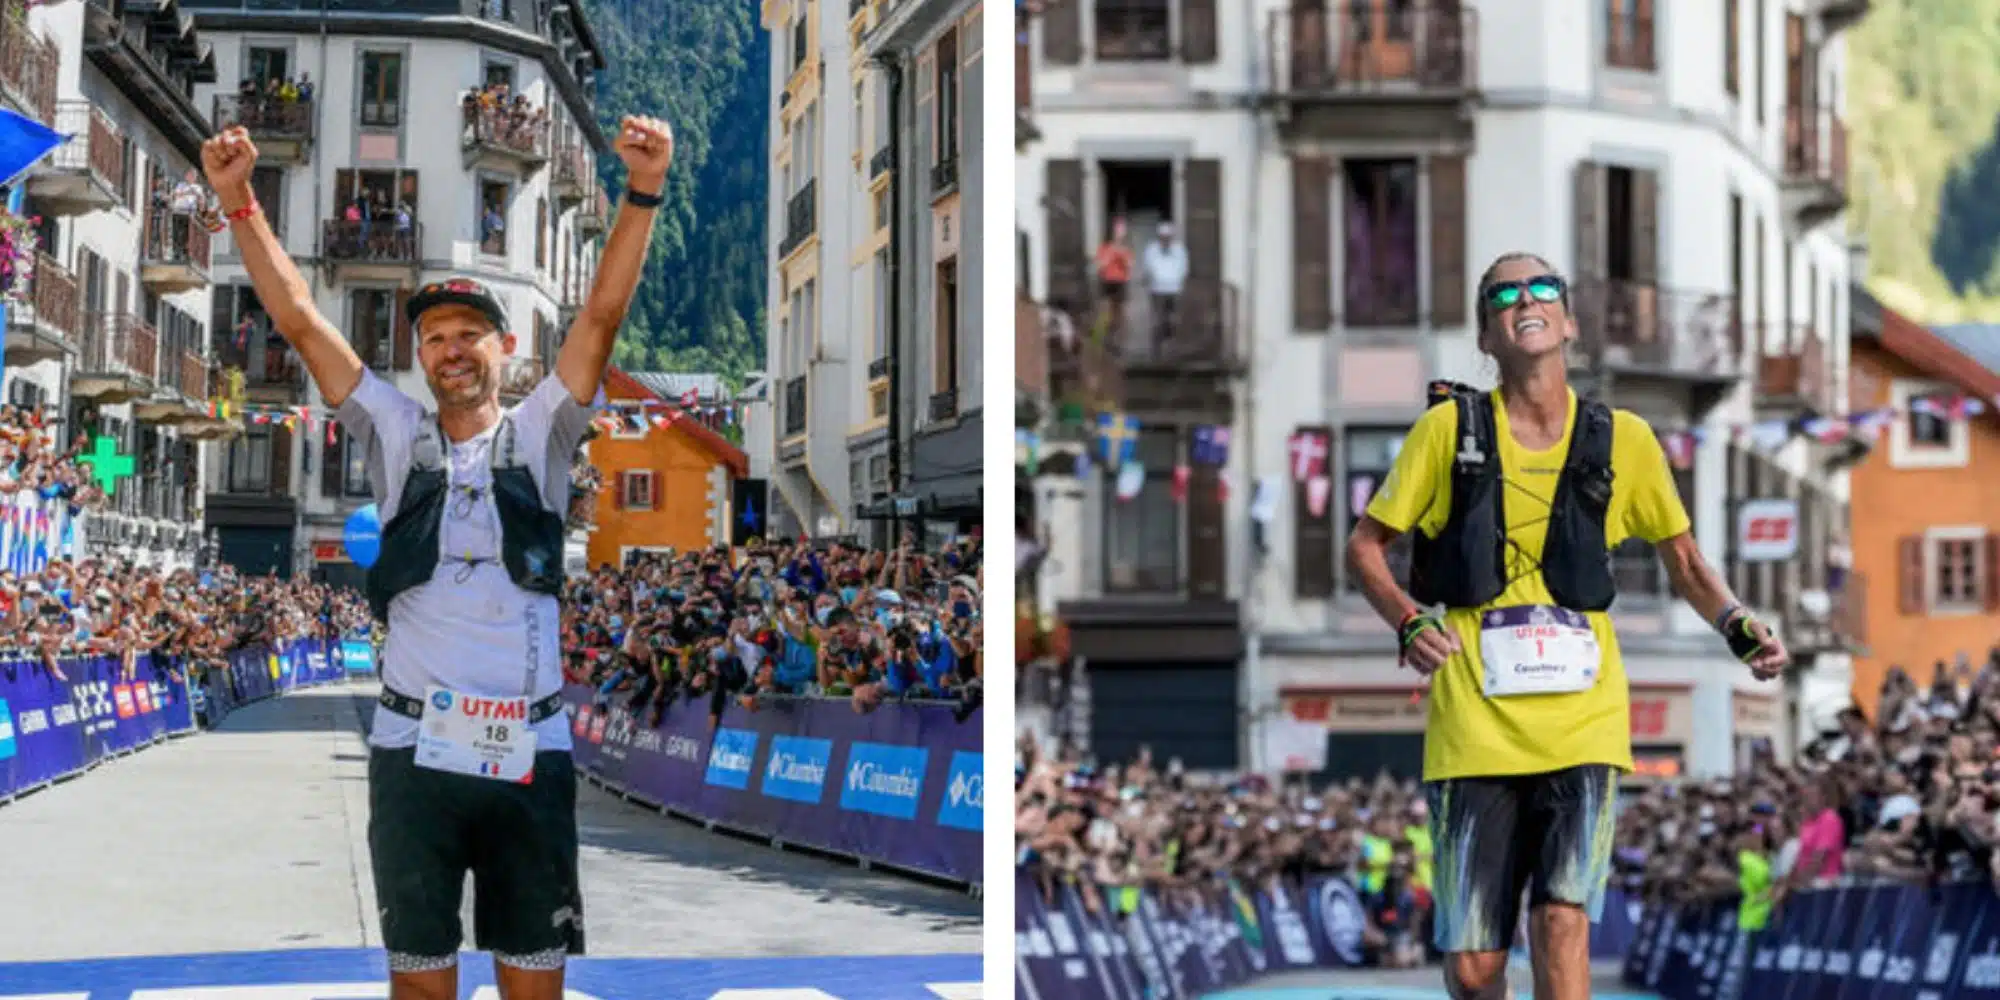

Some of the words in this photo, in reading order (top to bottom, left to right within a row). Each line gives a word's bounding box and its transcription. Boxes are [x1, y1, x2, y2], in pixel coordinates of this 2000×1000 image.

[1536, 639, 1545, 659] 1
[486, 725, 509, 742] 18
[860, 762, 918, 797] Columbia
